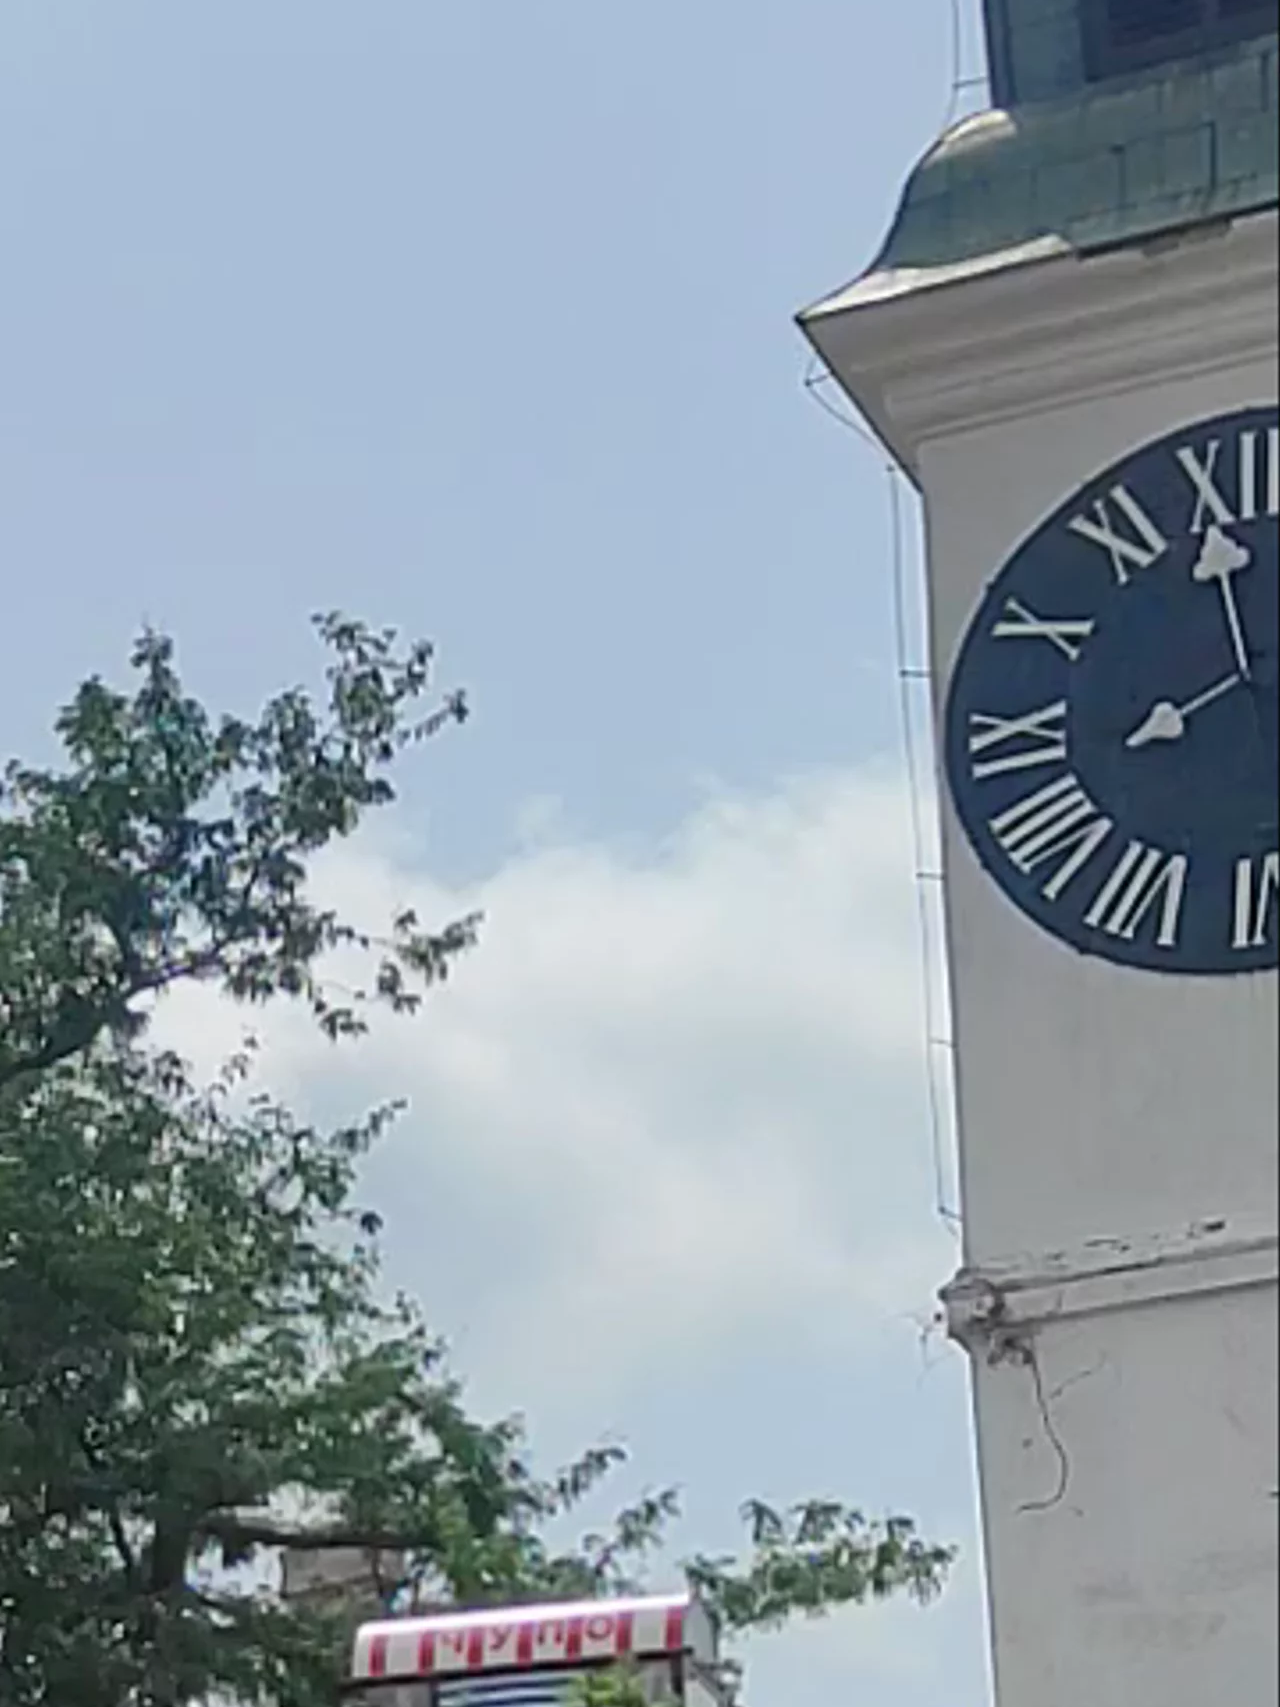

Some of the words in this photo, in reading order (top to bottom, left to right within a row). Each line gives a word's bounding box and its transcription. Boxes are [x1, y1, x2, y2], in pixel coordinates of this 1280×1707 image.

[1176, 427, 1278, 532] XII
[1069, 485, 1167, 584] XI
[992, 597, 1094, 660] X
[969, 699, 1067, 779] IX
[989, 773, 1113, 901] VIII
[1083, 840, 1187, 945] VII
